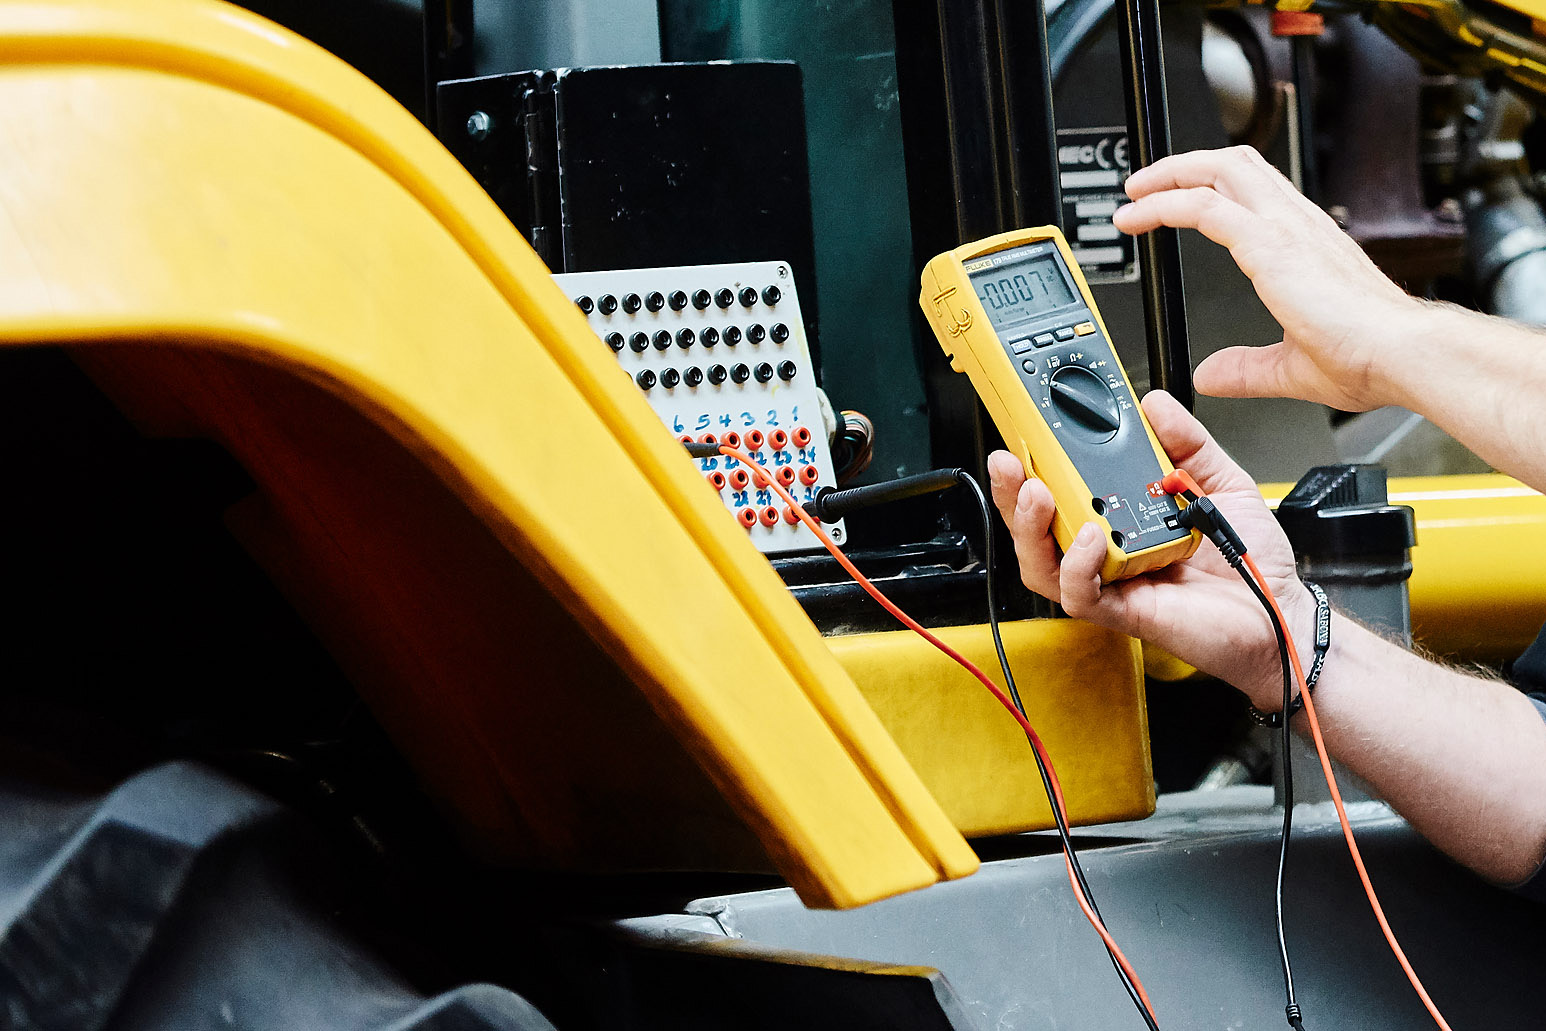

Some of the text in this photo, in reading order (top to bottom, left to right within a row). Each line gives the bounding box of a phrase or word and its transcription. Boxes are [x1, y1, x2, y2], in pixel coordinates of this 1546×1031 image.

[966, 258, 992, 272] FLUKE
[673, 405, 798, 433] 6 5 4 3 2 1
[701, 457, 718, 471] 20
[773, 450, 792, 466] 23
[798, 446, 816, 465] 24
